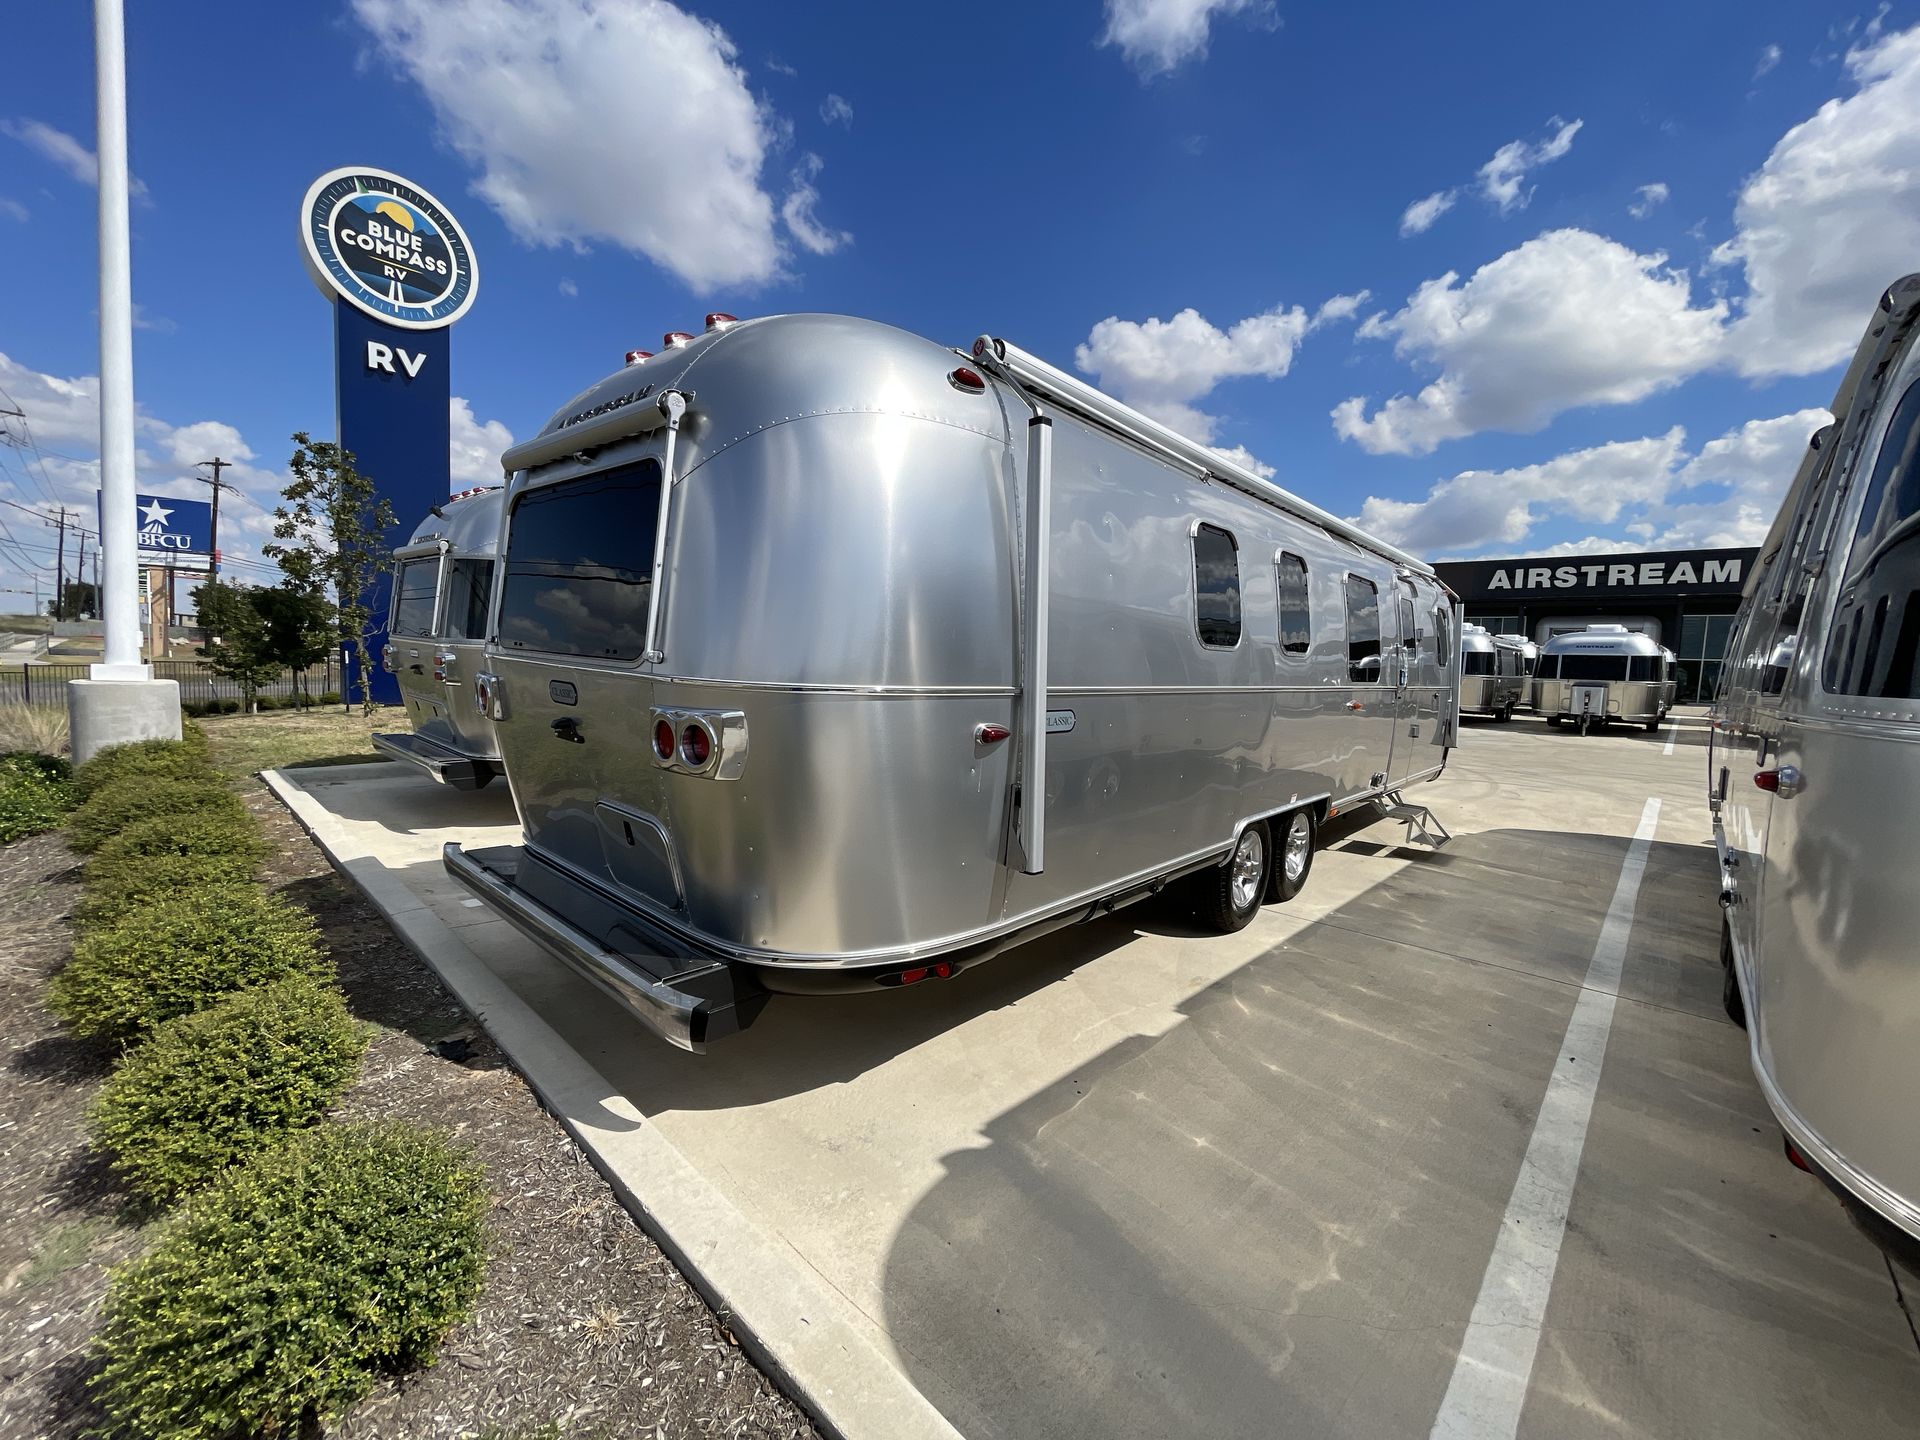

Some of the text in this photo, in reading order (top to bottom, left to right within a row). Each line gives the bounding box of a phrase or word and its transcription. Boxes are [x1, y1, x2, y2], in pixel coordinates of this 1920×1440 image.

[368, 220, 422, 252] BLUE
[341, 229, 447, 275] COMPASS
[384, 265, 407, 281] RV
[368, 340, 427, 377] RV
[1487, 559, 1742, 590] AIRSTREAM
[1046, 716, 1072, 726] LASSIC
